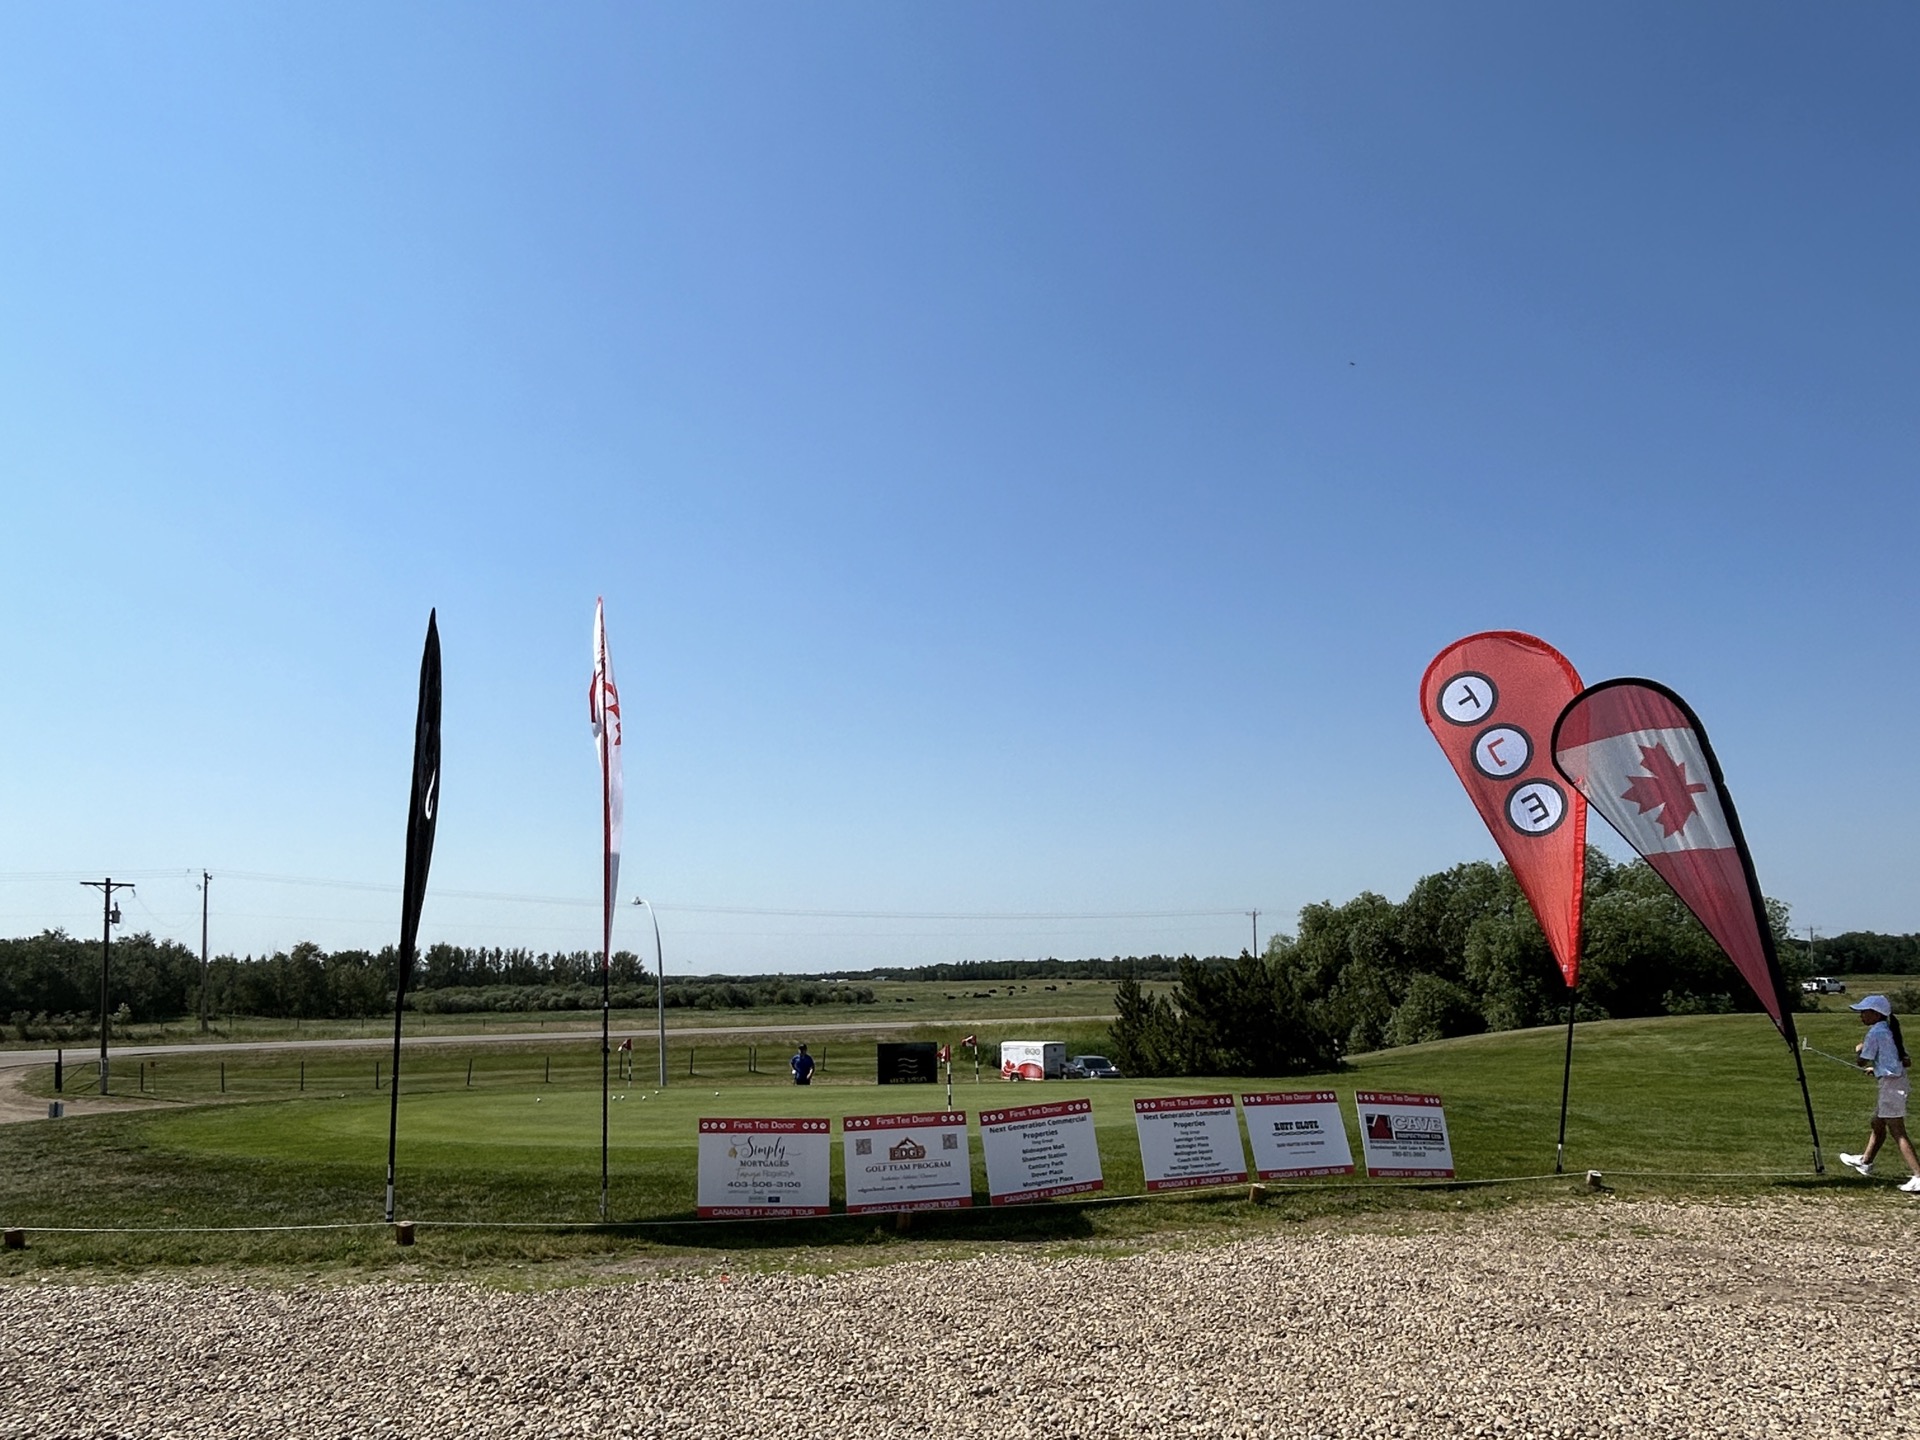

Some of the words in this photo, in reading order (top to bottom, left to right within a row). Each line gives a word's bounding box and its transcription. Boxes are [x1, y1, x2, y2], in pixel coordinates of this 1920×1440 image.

[1042, 1106, 1063, 1114] Donor
[1196, 1109, 1230, 1117] Commercial
[733, 1121, 752, 1129] First
[755, 1121, 769, 1129] Tee
[771, 1121, 796, 1129] Donor
[1008, 1122, 1046, 1131] Generation
[1047, 1115, 1086, 1126] Commercial
[1392, 1115, 1443, 1131] CAVE
[1023, 1129, 1058, 1139] Properties
[741, 1135, 786, 1159] Simply
[893, 1148, 924, 1158] EDGE
[866, 1165, 887, 1173] GOLF
[889, 1163, 911, 1171] TEAM
[912, 1161, 951, 1170] PROGRAM
[1023, 1177, 1058, 1187] Montgomery
[1158, 1180, 1189, 1188] CANADA'S
[1004, 1191, 1039, 1203] CANADA'S
[1051, 1187, 1074, 1196] JUNIOR
[1076, 1184, 1092, 1192] TOUR
